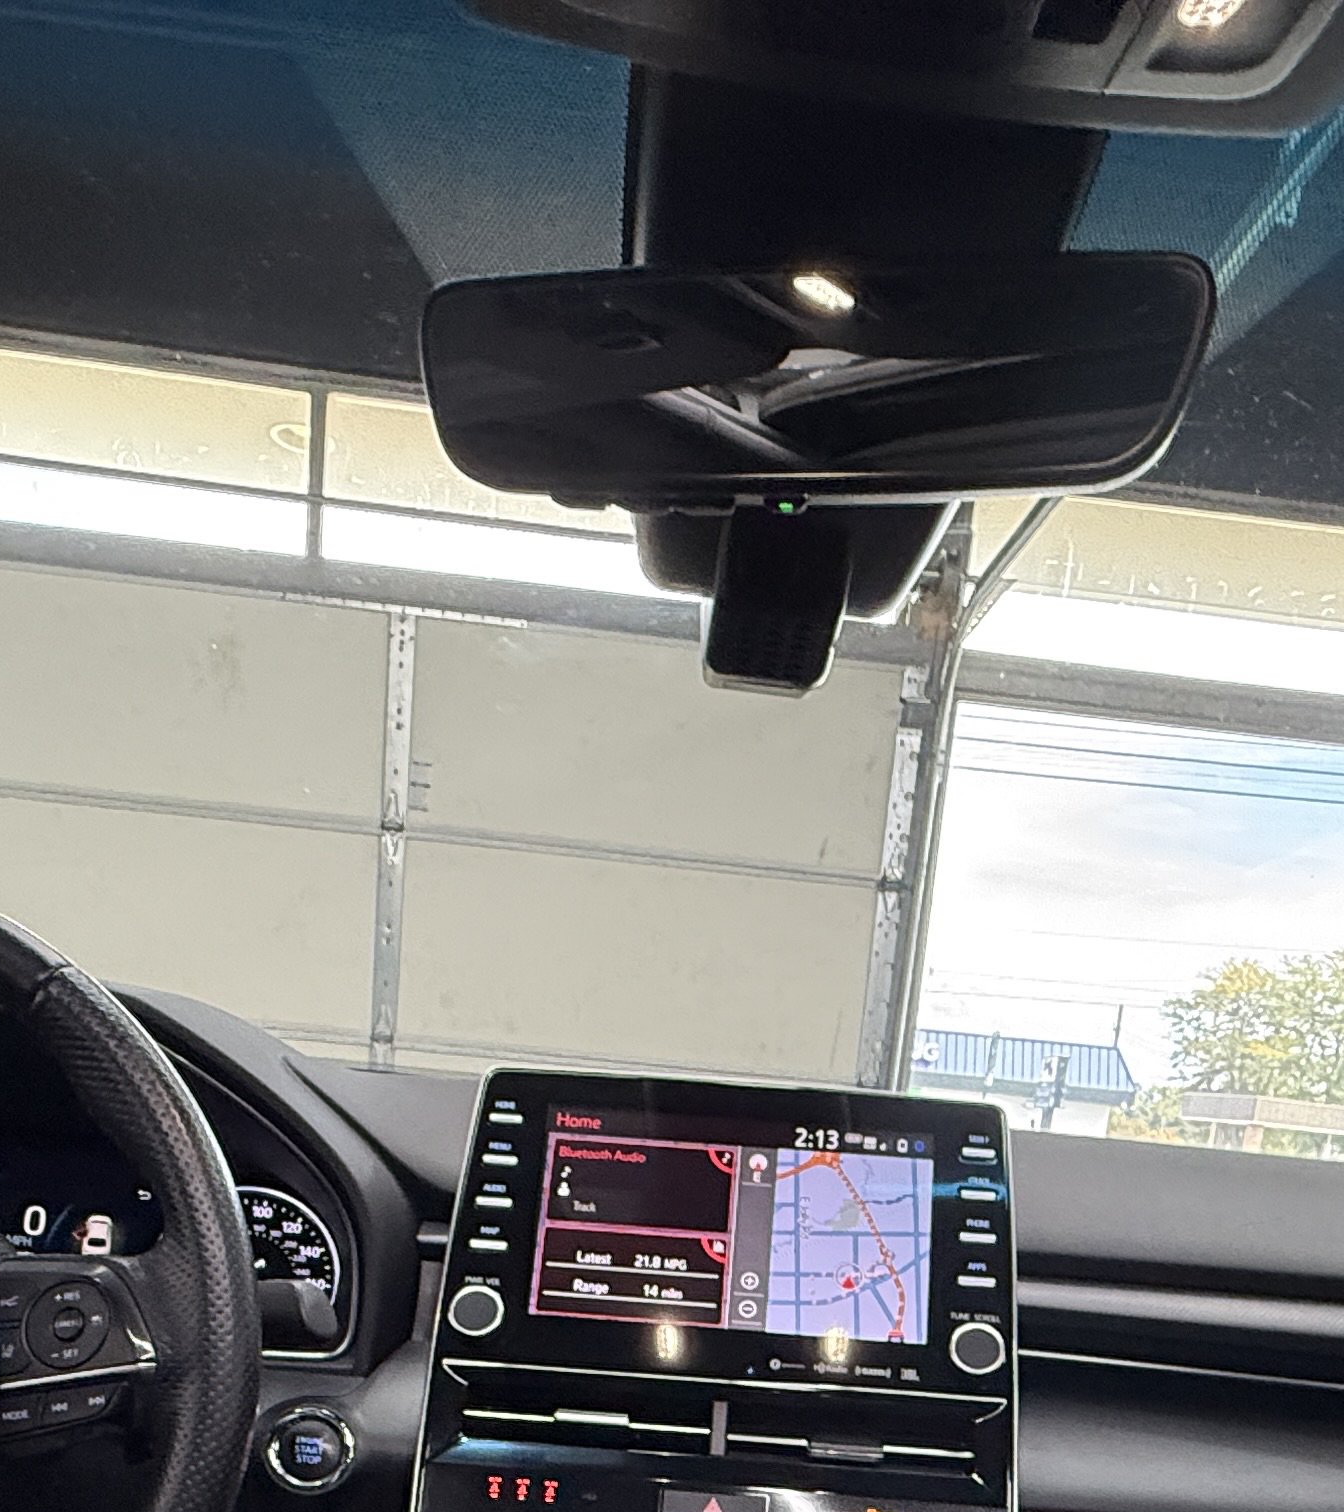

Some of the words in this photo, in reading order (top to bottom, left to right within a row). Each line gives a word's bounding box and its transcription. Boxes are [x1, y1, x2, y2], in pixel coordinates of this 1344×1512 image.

[556, 1112, 602, 1130] Home
[794, 1127, 840, 1150] 2:13
[559, 1145, 613, 1162] Bluetooth
[613, 1150, 647, 1164] Audio
[252, 1205, 274, 1219] 100
[573, 1200, 597, 1213] Track
[23, 1205, 47, 1237] 0
[281, 1221, 303, 1235] 120
[6, 1233, 33, 1247] MPH
[298, 1245, 322, 1259] 140
[576, 1249, 613, 1266] Latest
[663, 1258, 688, 1271] MPG
[572, 1278, 610, 1296] Range
[642, 1284, 660, 1298] 14
[2, 1409, 30, 1421] MODE
[295, 1455, 323, 1465] STOP
